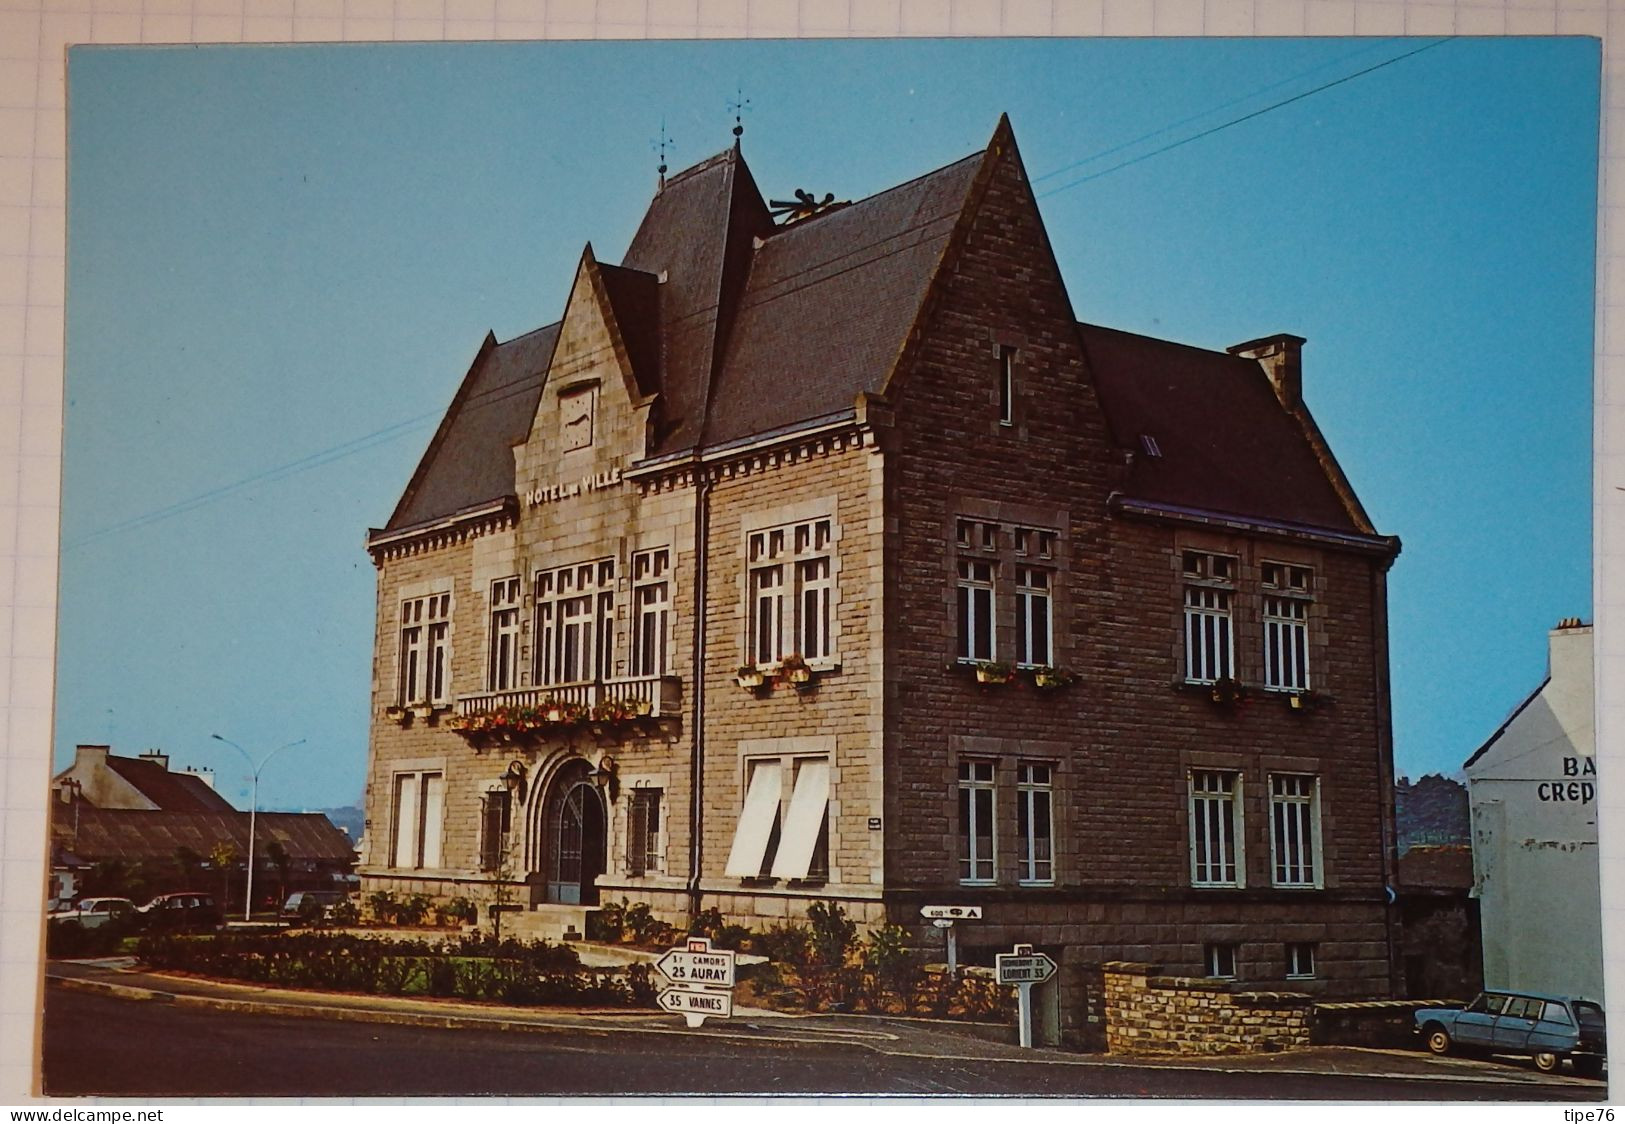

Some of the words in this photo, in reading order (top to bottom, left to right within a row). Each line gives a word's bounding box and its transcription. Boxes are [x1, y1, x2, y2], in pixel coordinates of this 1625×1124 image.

[525, 482, 567, 508] HOTEL
[582, 466, 622, 492] VILLE
[1563, 756, 1597, 777] BA
[1537, 782, 1595, 805] CREP
[692, 956, 726, 966] CAMORS
[672, 966, 686, 978] 25
[690, 967, 727, 981] AURAY
[669, 994, 682, 1007] 35
[688, 996, 722, 1011] VANNES
